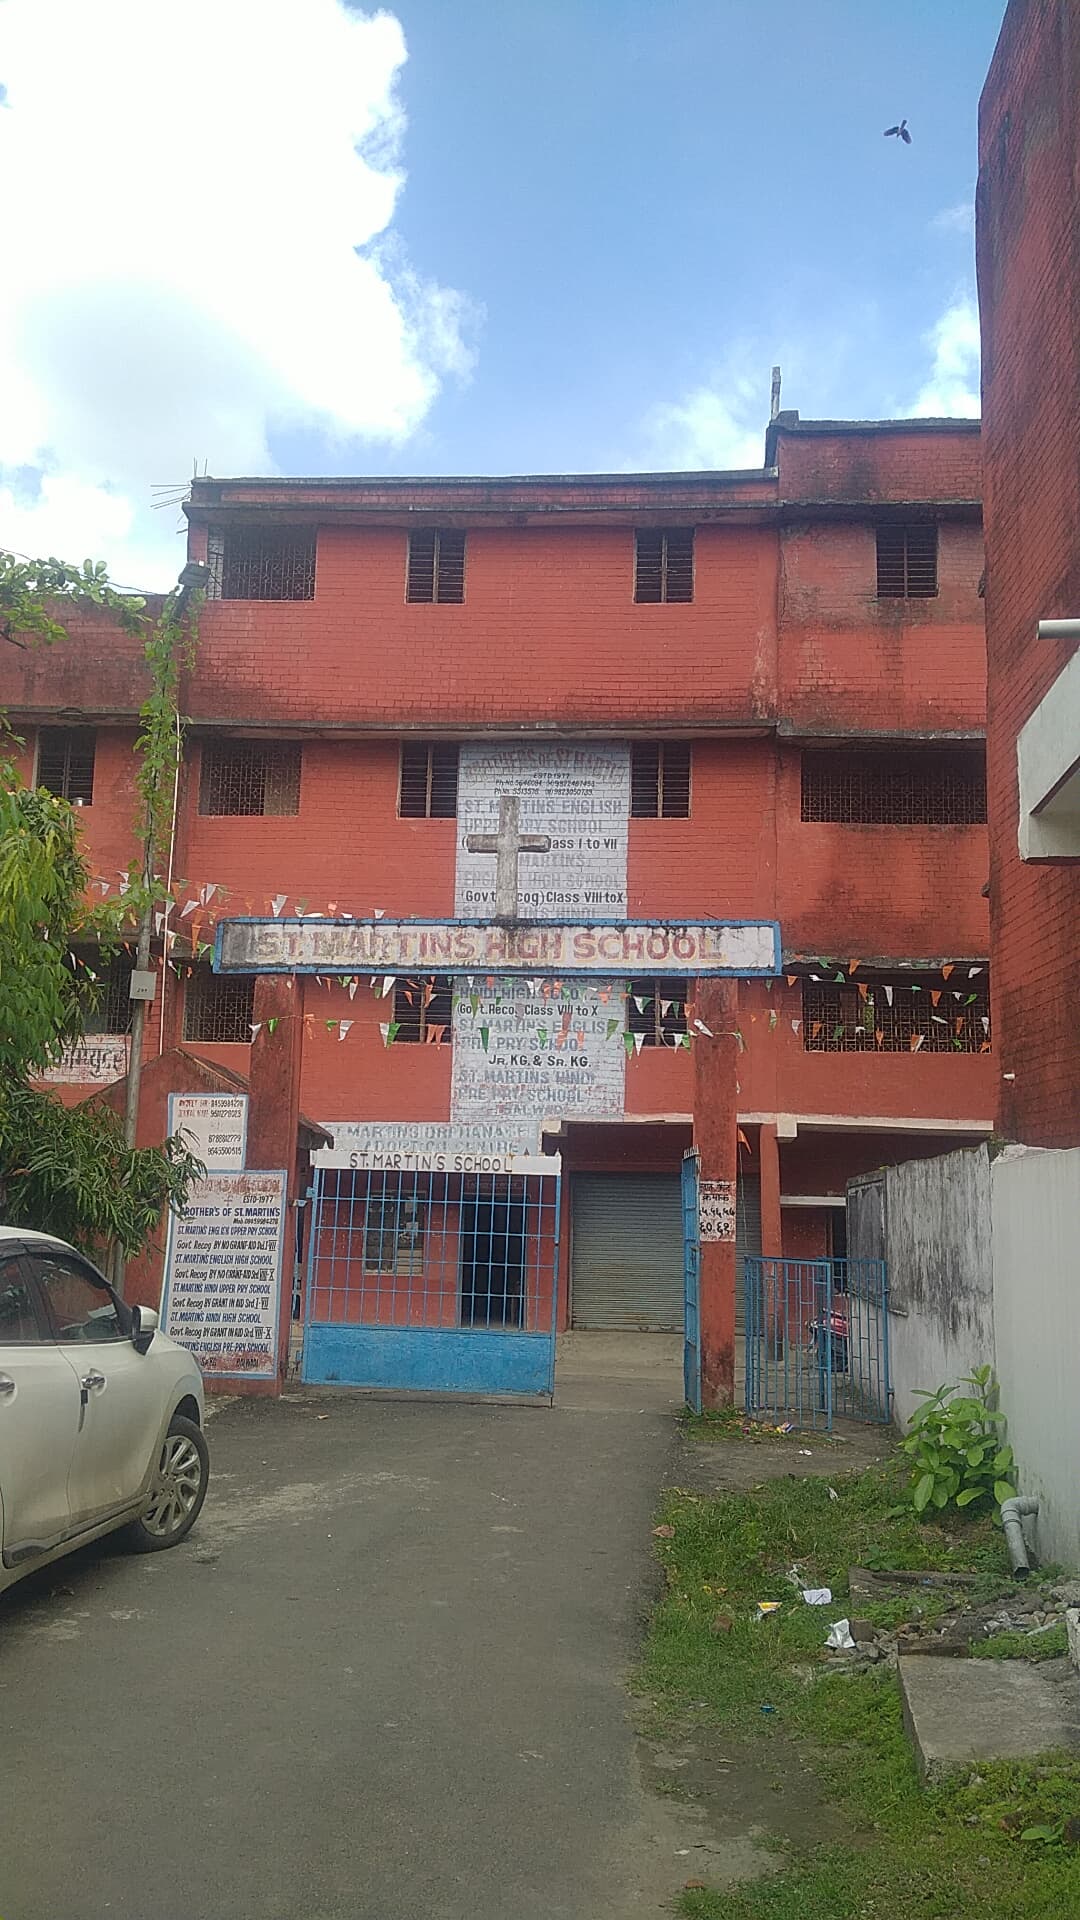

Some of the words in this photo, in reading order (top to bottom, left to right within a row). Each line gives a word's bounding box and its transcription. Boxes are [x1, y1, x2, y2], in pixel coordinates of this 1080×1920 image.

[562, 799, 622, 815] ENGLISH
[549, 838, 574, 849] lass
[586, 838, 600, 850] to
[603, 838, 617, 849] VII
[484, 931, 563, 960] HIGH
[573, 932, 723, 962] SCHOOL
[524, 1004, 553, 1016] Class
[577, 1004, 589, 1015] to
[591, 1005, 599, 1016] X
[497, 1037, 523, 1051] PRY
[510, 1055, 530, 1067] KG.
[533, 1055, 543, 1066] &
[570, 1055, 592, 1067] KG.
[484, 1070, 549, 1084] MARTINS
[528, 1087, 584, 1102] SCHOOL
[454, 1155, 513, 1173] SCHOOL
[222, 1208, 232, 1217] OF
[230, 1226, 247, 1236] UPPER
[247, 1226, 257, 1236] PRY
[258, 1226, 278, 1236] SCHOOL
[194, 1241, 212, 1251] Recog
[213, 1240, 221, 1250] BY
[221, 1240, 230, 1250] NO
[209, 1253, 234, 1265] ENGLISH
[234, 1254, 249, 1264] HIGH
[249, 1254, 273, 1266] SCHOOL
[190, 1269, 208, 1281] Recog
[209, 1269, 217, 1279] BY
[204, 1283, 219, 1293] HINDI
[219, 1283, 236, 1294] UPPER
[236, 1283, 248, 1293] PRY
[249, 1284, 271, 1294] SCHOOL
[186, 1298, 204, 1310] Recog
[204, 1297, 212, 1308] BY
[211, 1298, 228, 1308] GRANT
[229, 1298, 235, 1308] IN
[235, 1298, 245, 1308] AID
[204, 1312, 221, 1323] HINDI
[222, 1312, 237, 1323] HIGH
[237, 1313, 262, 1323] SCHOOL
[184, 1327, 202, 1339] Recog
[203, 1327, 211, 1338] BY
[210, 1327, 228, 1338] GRANT
[228, 1327, 234, 1338] IN
[234, 1328, 245, 1338] AID
[200, 1341, 222, 1351] ENGLISH
[246, 1342, 270, 1353] SCHOOL
